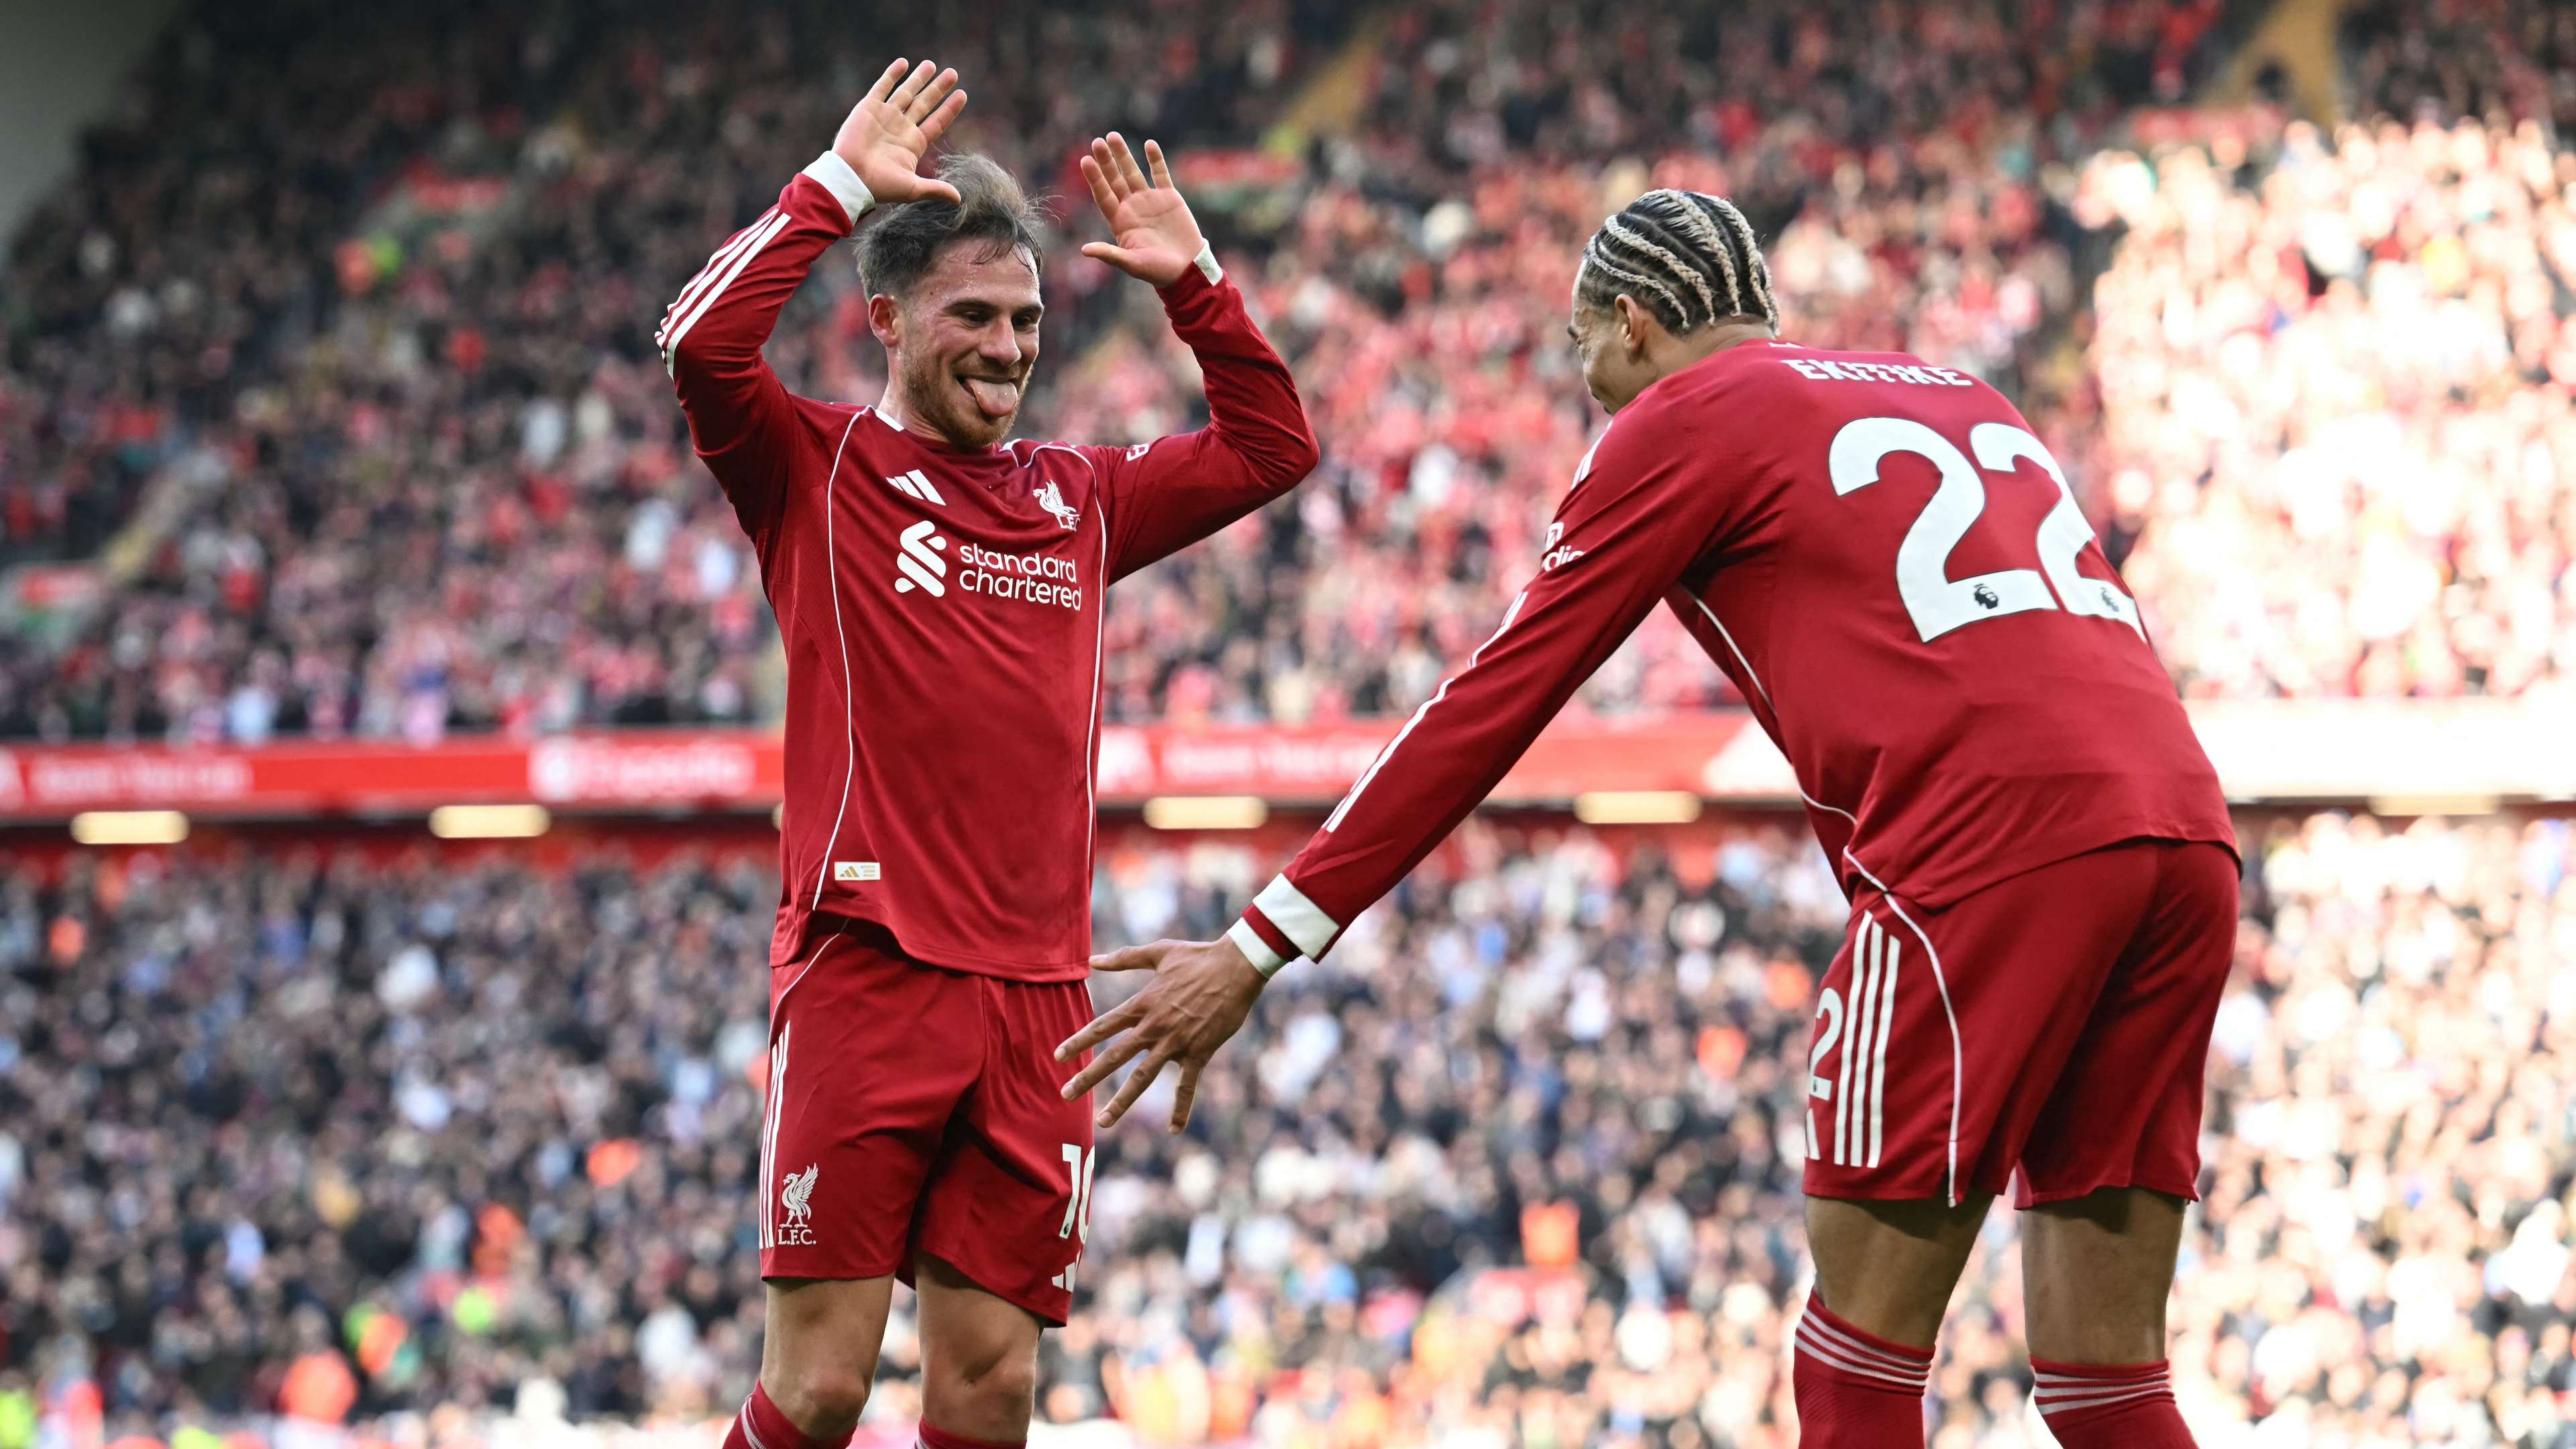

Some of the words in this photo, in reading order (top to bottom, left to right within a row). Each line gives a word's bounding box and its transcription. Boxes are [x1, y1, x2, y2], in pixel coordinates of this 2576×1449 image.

[1828, 416, 2147, 643] 22
[959, 543, 1077, 584] standard
[959, 566, 1082, 612] chartered
[777, 1229, 817, 1245] L.F.C.
